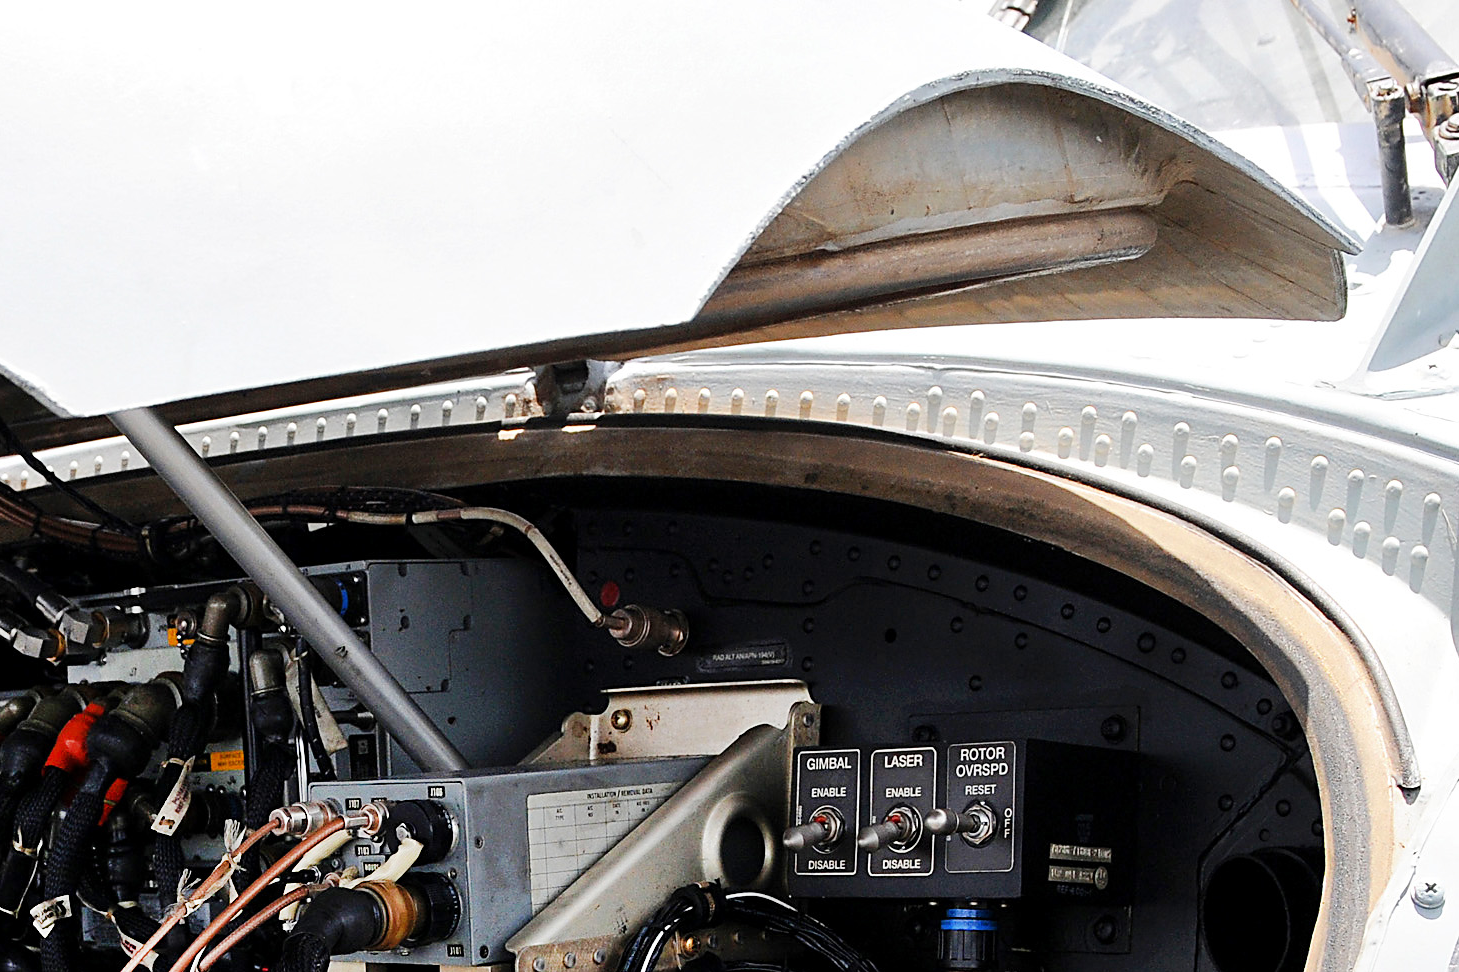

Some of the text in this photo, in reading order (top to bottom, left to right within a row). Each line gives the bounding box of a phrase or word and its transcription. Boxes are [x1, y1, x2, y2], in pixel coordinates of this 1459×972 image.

[961, 747, 1005, 761] ROTOR
[807, 757, 851, 770] GIMBAL
[885, 754, 923, 768] LASER
[956, 763, 1008, 777] OVRSPD
[587, 790, 617, 800] INSTALLATION
[621, 788, 641, 797] REMOVAL
[812, 787, 846, 797] ENABLE
[886, 787, 921, 798] ENABLE
[965, 784, 996, 795] RESET
[809, 860, 845, 870] DISABLE
[883, 859, 921, 870] DISABLE
